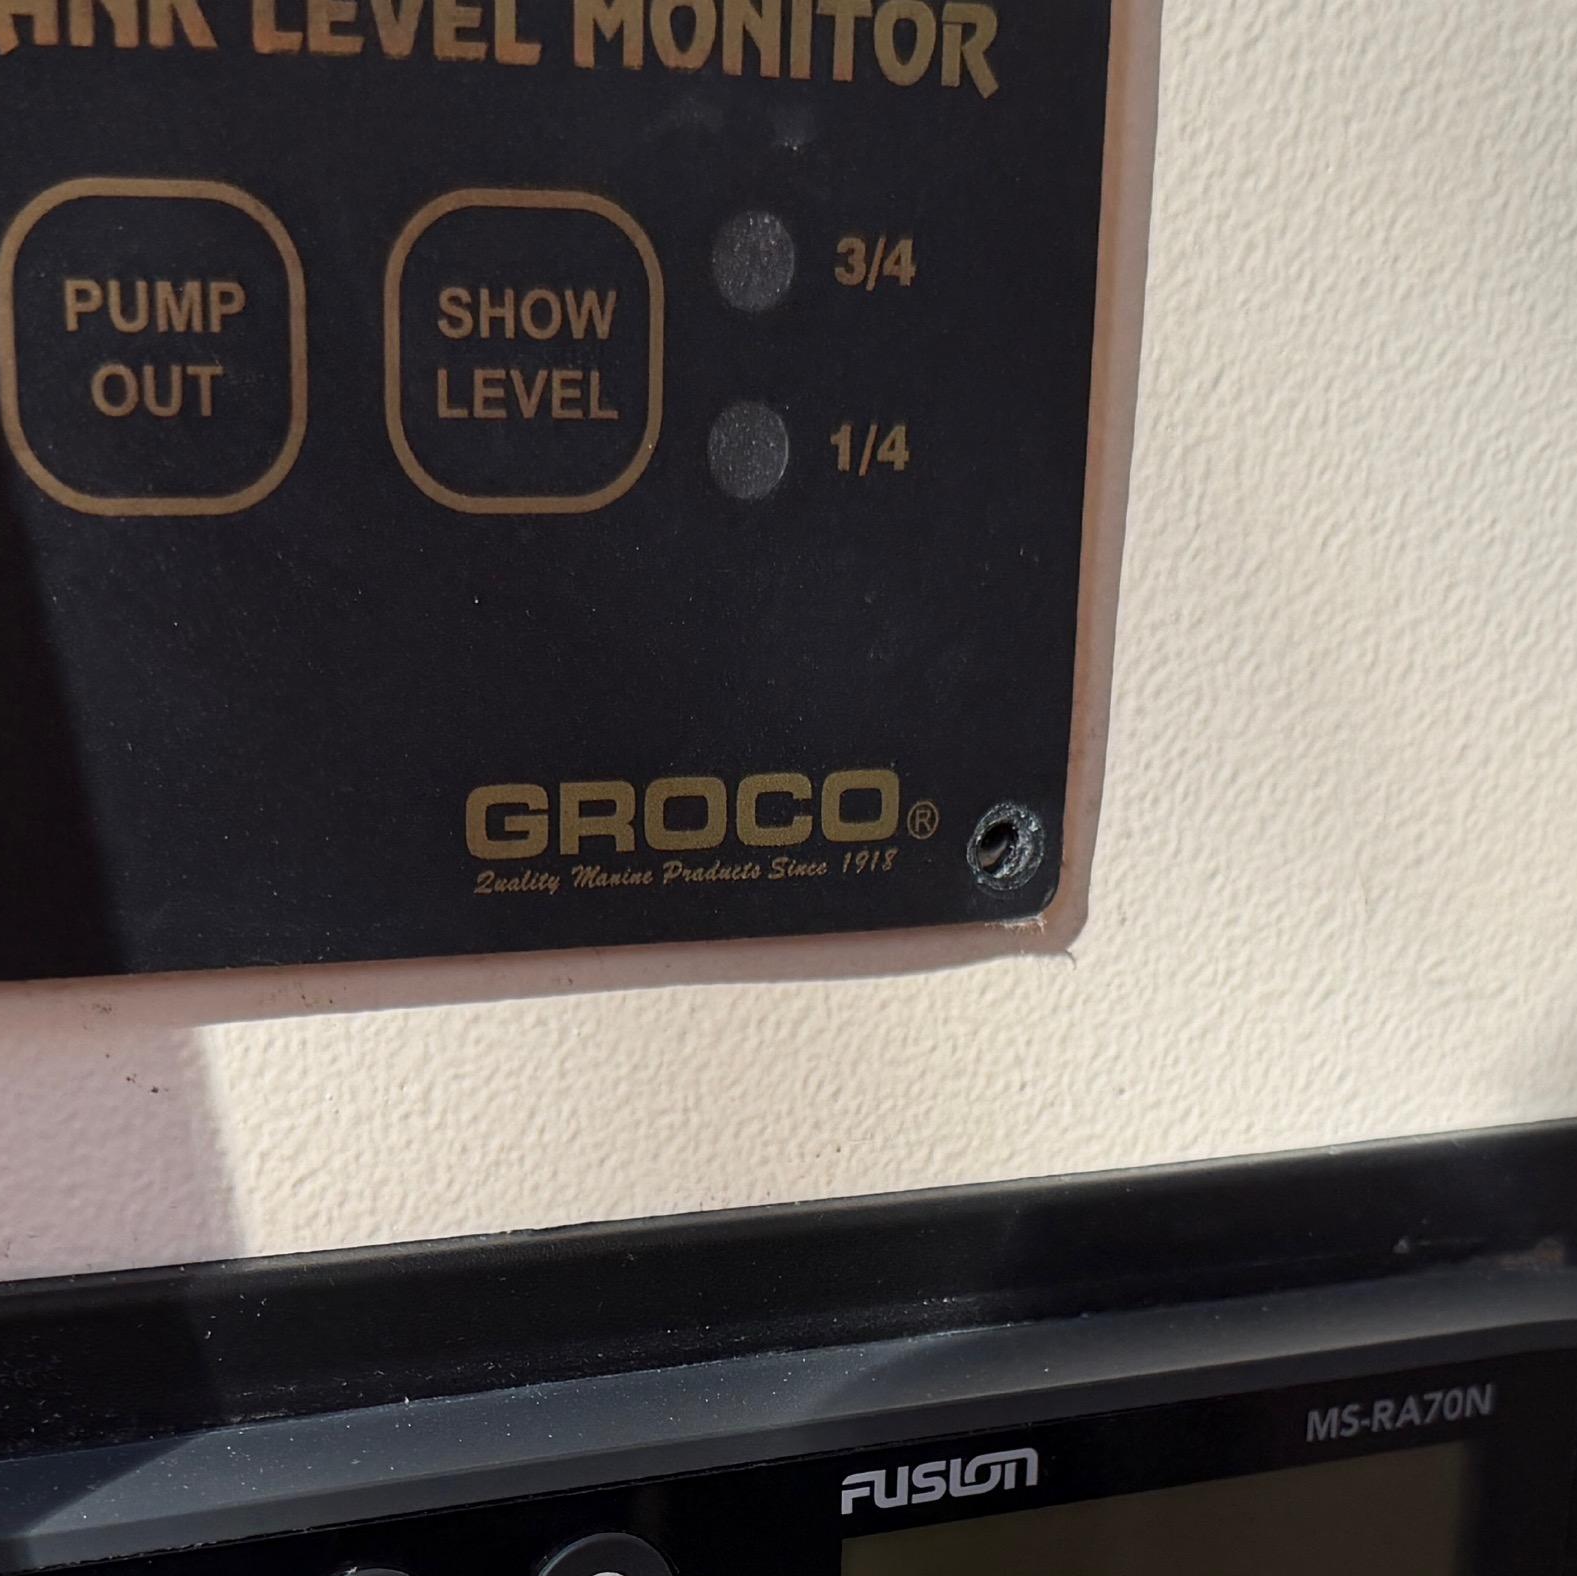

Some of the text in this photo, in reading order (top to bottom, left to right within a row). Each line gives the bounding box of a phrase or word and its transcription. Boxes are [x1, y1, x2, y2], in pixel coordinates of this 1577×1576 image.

[253, 0, 542, 66] LEVEL
[573, 0, 1000, 99] MONITOR
[835, 237, 917, 288] 3/4
[64, 279, 246, 335] PUMP
[436, 287, 617, 341] SHOW
[91, 364, 224, 418] OUT
[437, 368, 619, 420] LEVEL
[830, 424, 910, 474] 1/4
[473, 848, 899, 895] Quality Marine Products Since 1918
[1306, 1383, 1496, 1442] MS-RA70N
[841, 1447, 1038, 1515] FUSION
